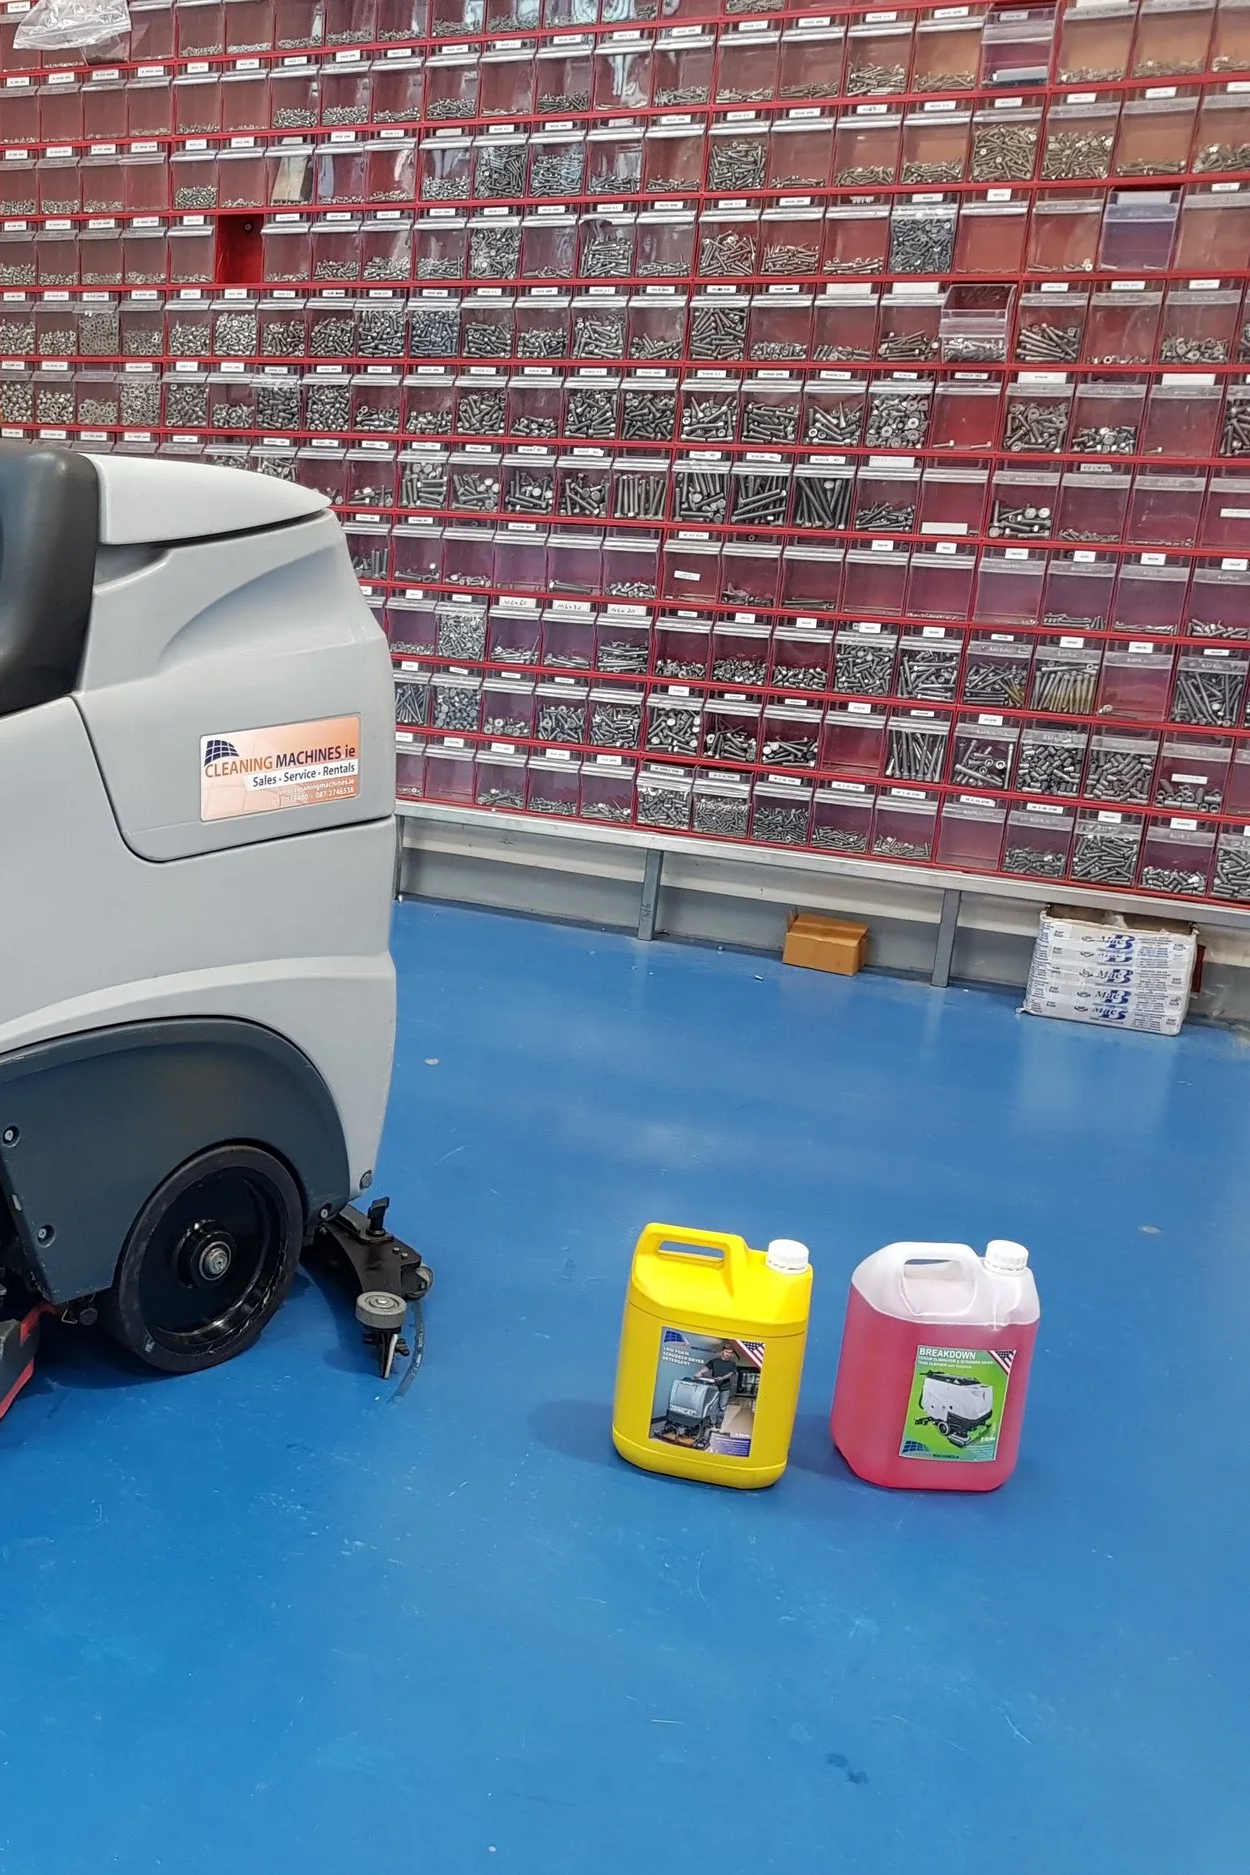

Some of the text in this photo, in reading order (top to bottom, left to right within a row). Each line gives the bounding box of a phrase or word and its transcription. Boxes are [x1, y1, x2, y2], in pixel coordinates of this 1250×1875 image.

[205, 755, 273, 779] CLEANING
[275, 745, 342, 769] MACHINES
[252, 762, 356, 788] Sales Service Rentals
[919, 1347, 977, 1360] BREAKDOWN
